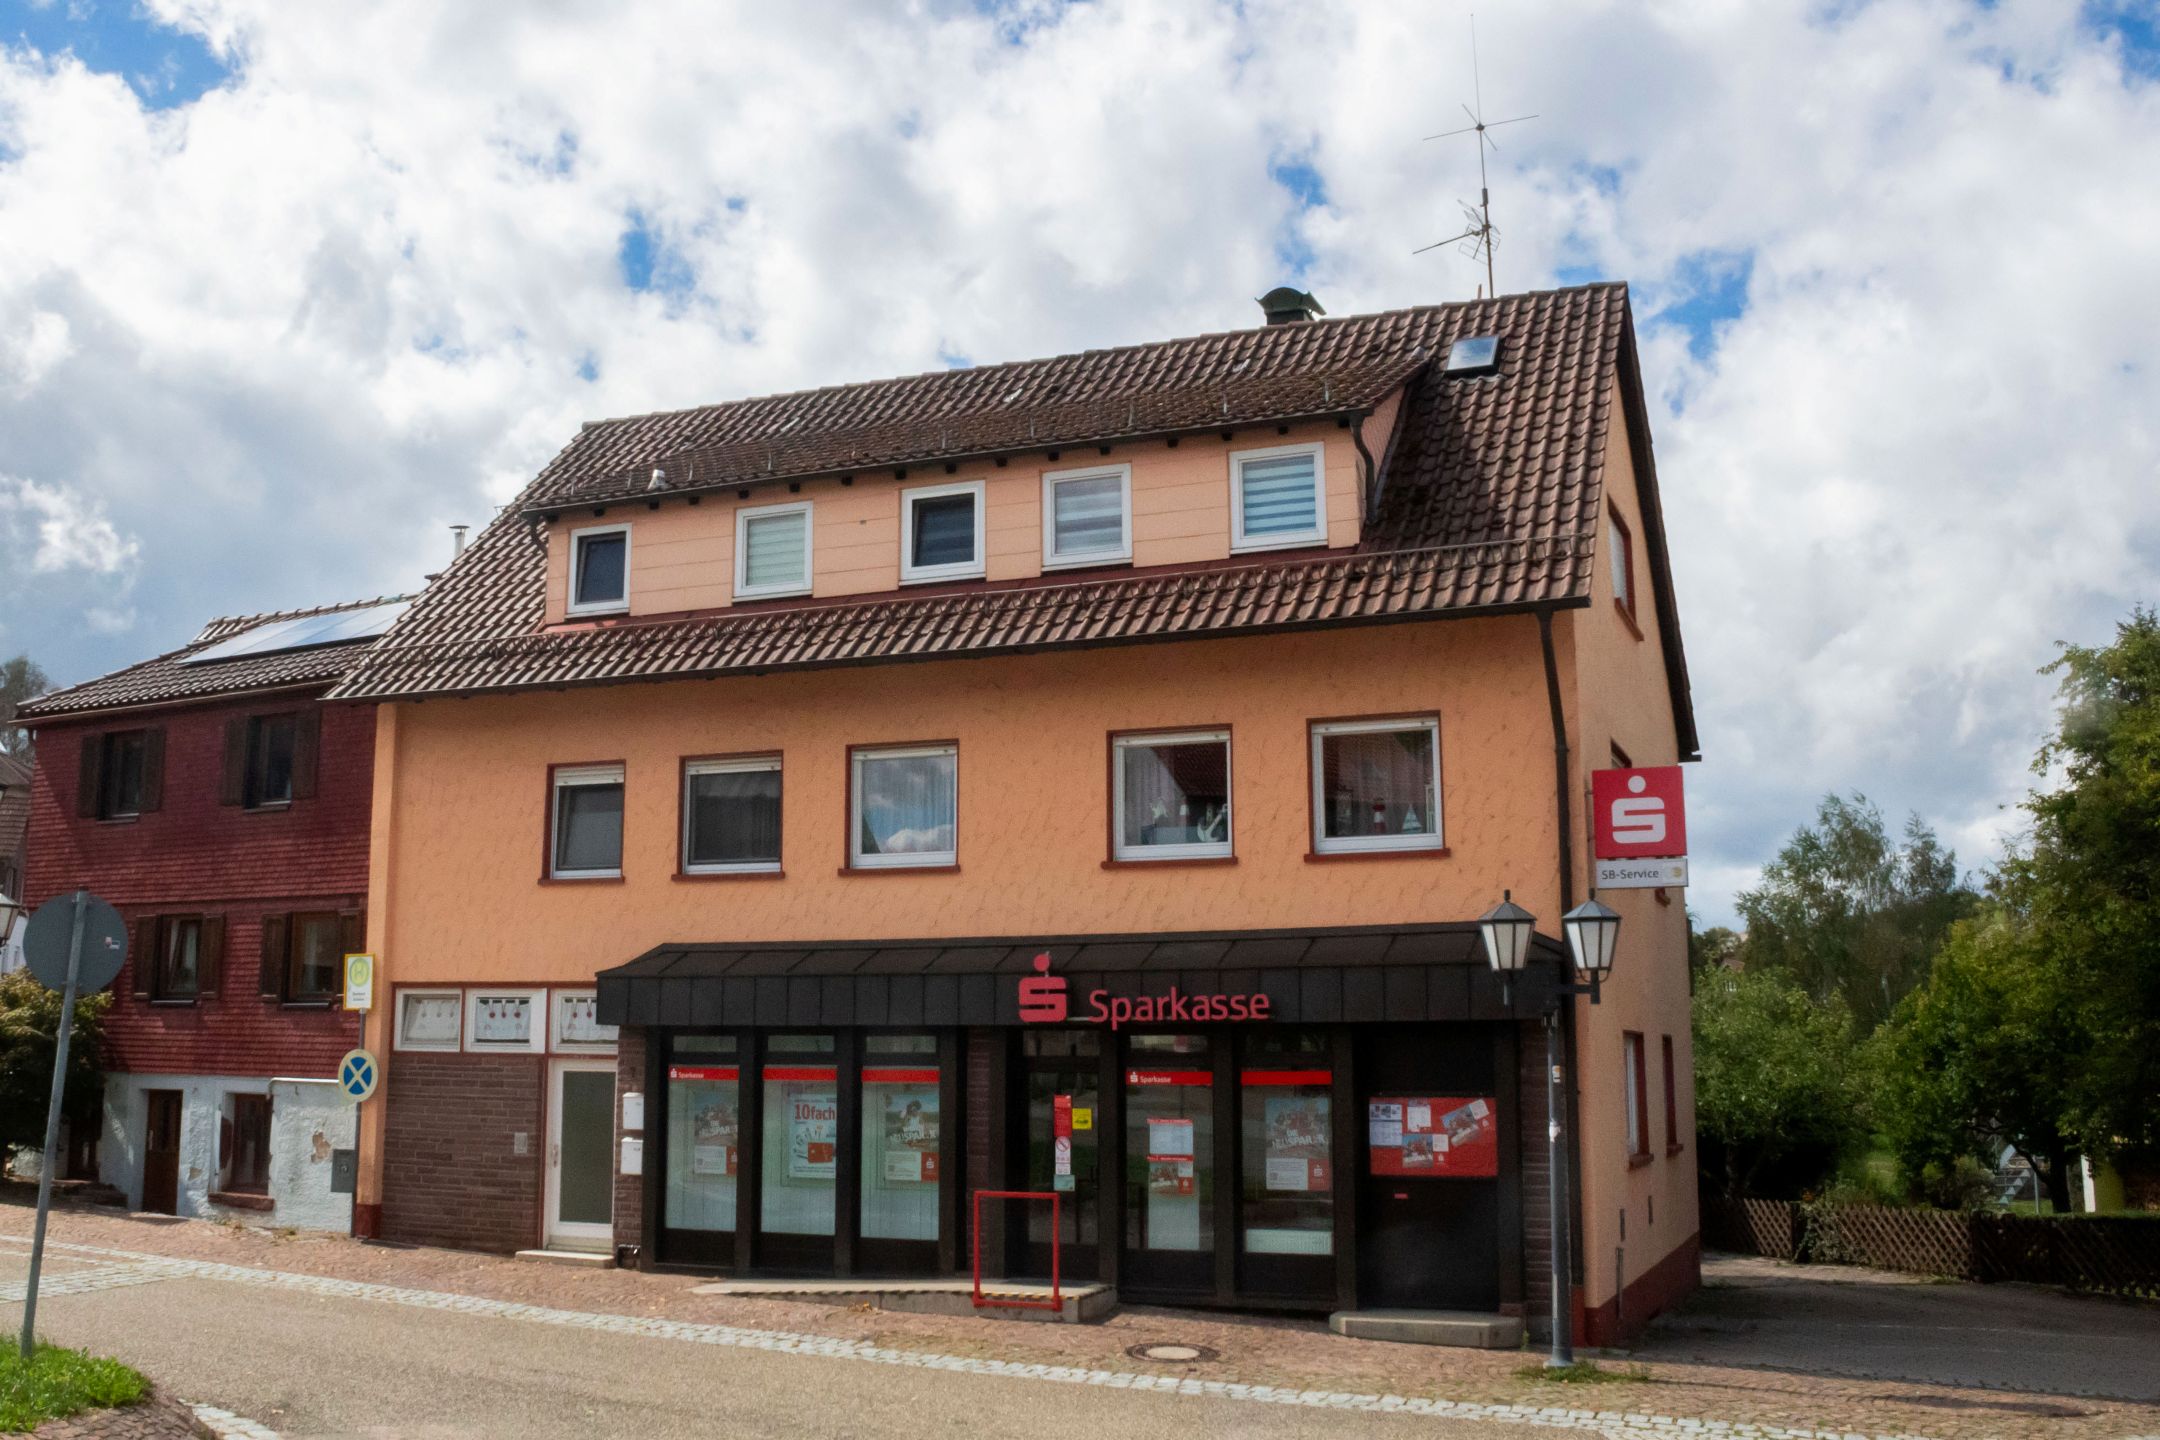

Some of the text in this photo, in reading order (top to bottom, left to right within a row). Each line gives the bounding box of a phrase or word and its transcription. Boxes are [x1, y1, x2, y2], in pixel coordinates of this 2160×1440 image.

[1601, 868, 1660, 881] SB-Service
[1088, 986, 1270, 1031] Sparkasse
[1140, 1075, 1172, 1085] Sparkasse
[794, 1103, 836, 1121] 10fach
